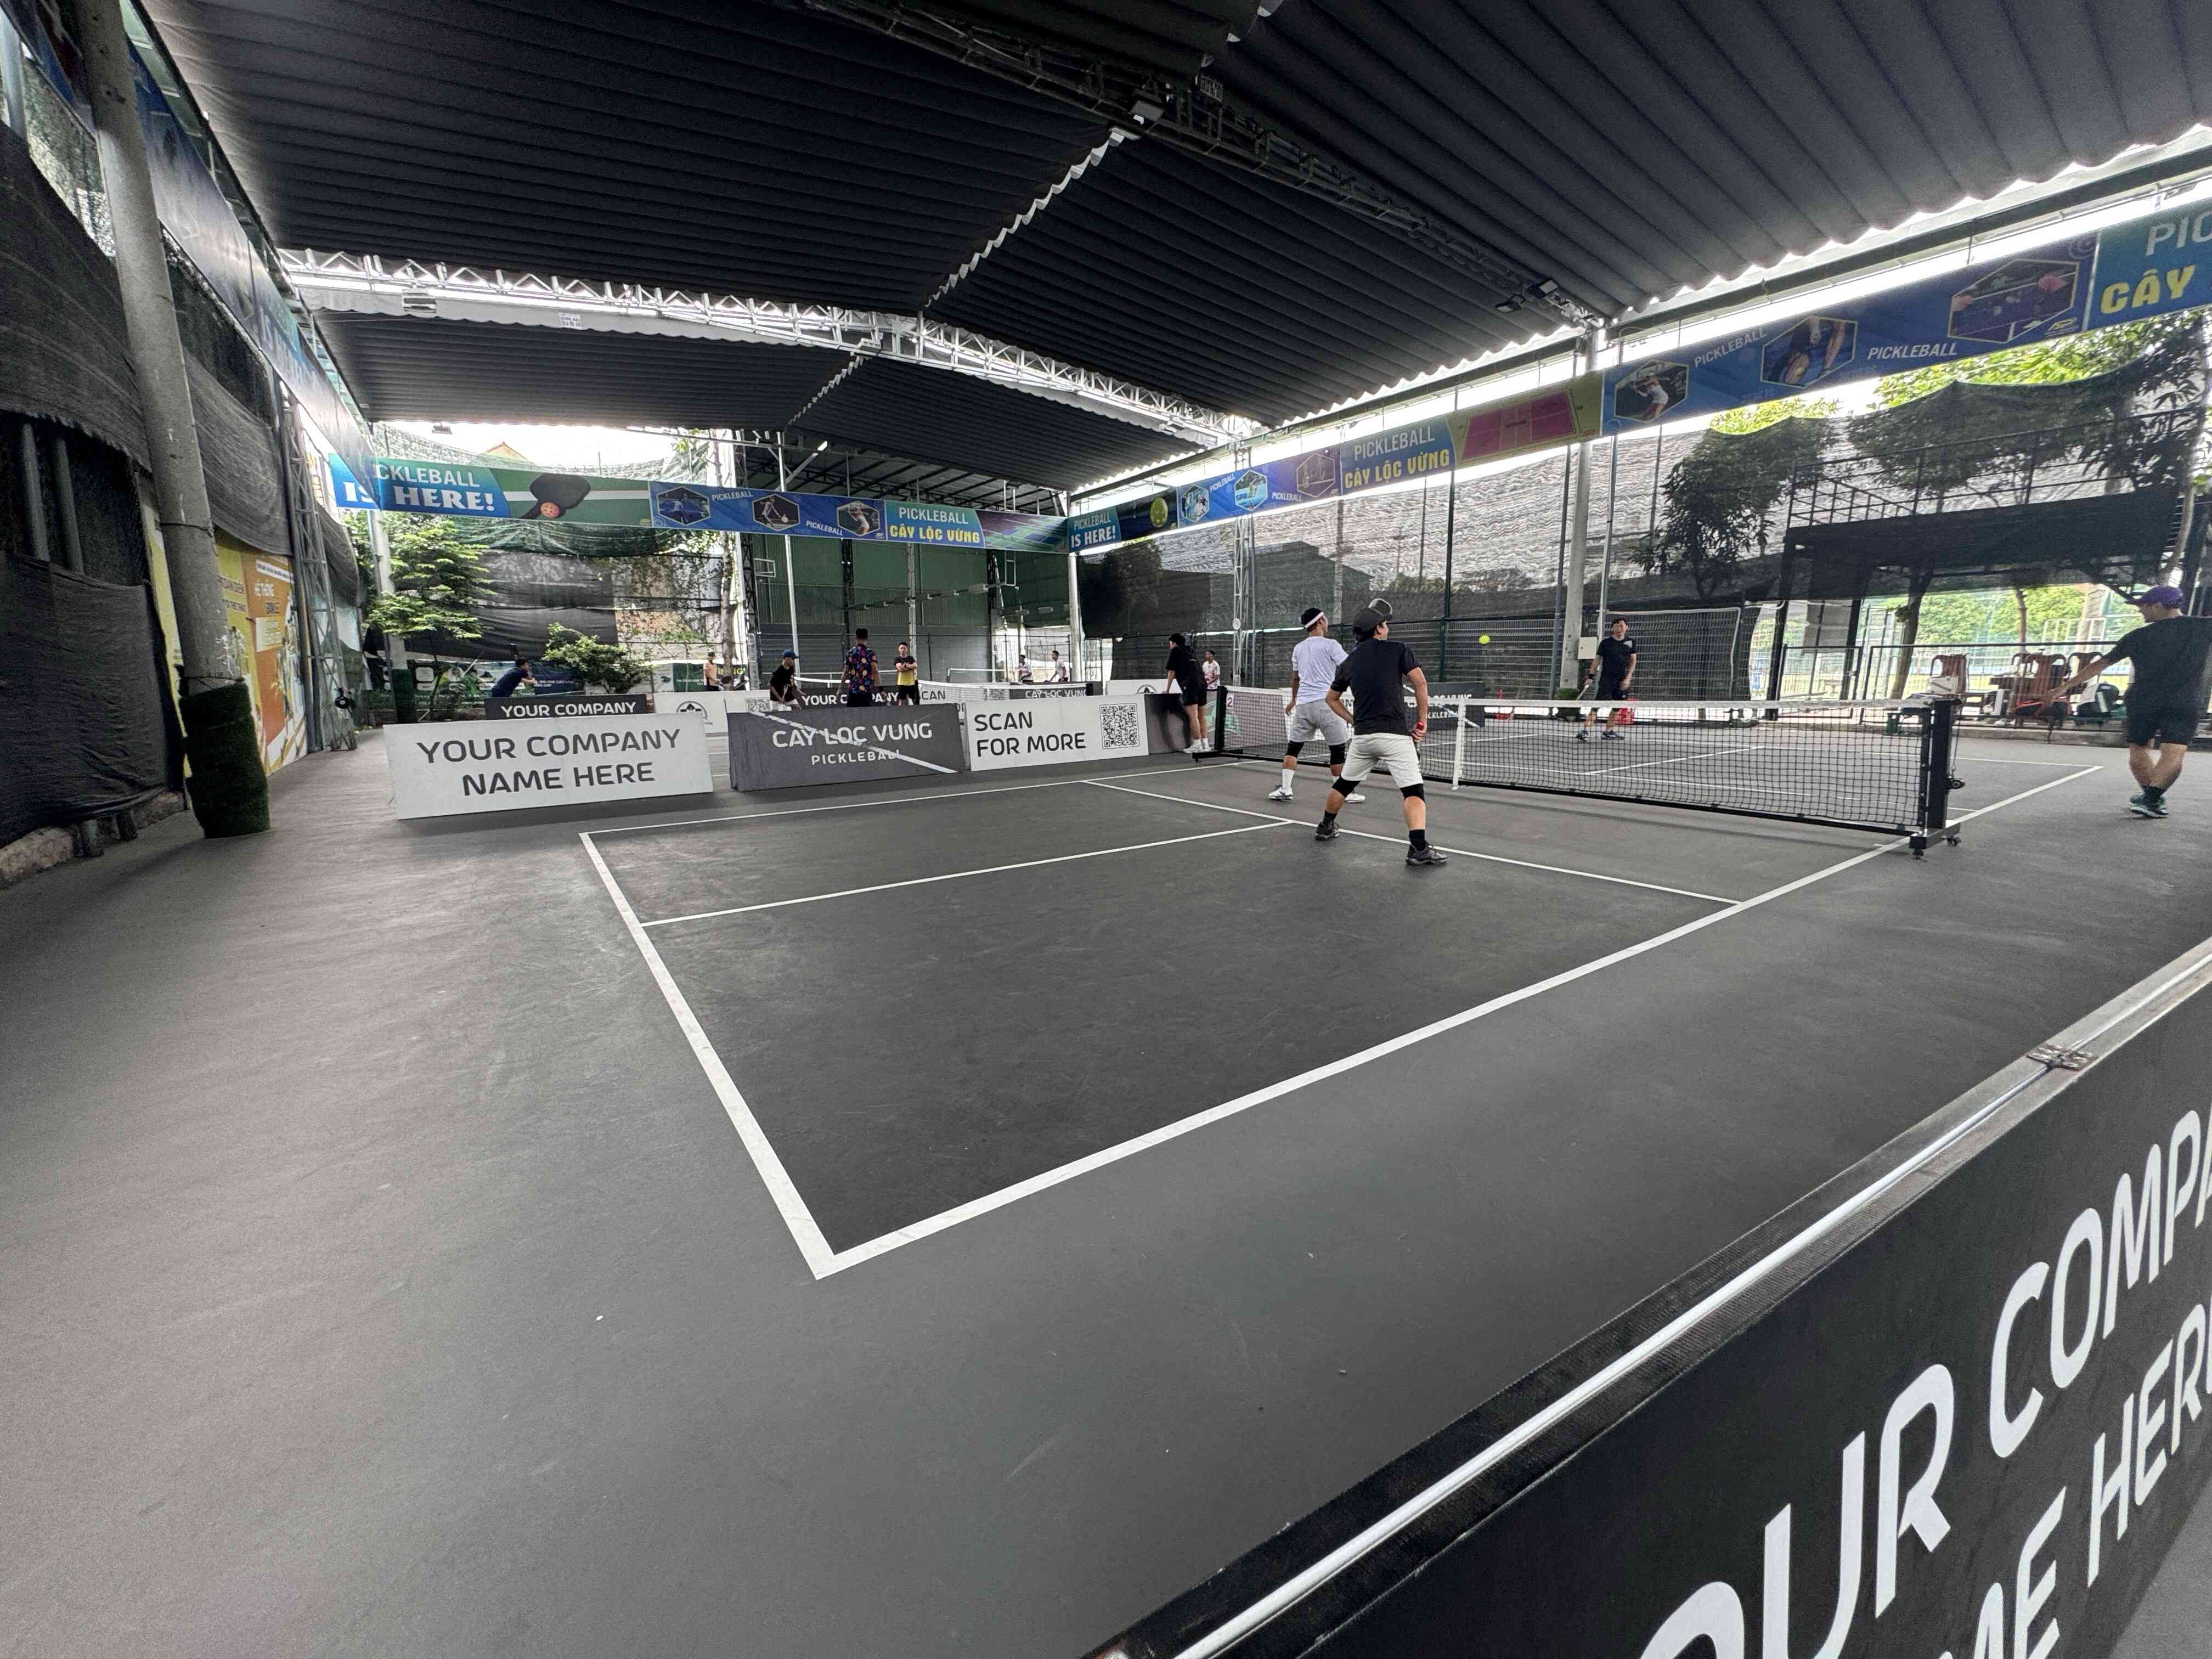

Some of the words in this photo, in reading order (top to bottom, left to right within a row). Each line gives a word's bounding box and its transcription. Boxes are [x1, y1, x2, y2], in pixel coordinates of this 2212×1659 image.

[2100, 265, 2196, 314] CÂY
[1694, 327, 1767, 368] PICKLEBALL
[1867, 342, 1958, 360] PICKLEBALL
[1354, 426, 1436, 461] PICKLEBALL
[376, 464, 480, 488] CKLEBALL
[1345, 466, 1370, 489] CÂY
[1375, 460, 1402, 483] LỘC
[1407, 449, 1450, 475] VỪNG
[1210, 473, 1236, 493] PICKLEBALL
[393, 484, 495, 512] HERE!
[712, 490, 754, 501] PICKLEBALL
[1271, 492, 1303, 502] PICKLEBALL
[898, 507, 969, 525] PICKLEBALL
[1074, 512, 1111, 531] PICKLEBALL
[806, 520, 843, 536] PICKLEBALL
[889, 523, 915, 539] CÂY
[919, 526, 943, 543] LỘC
[946, 528, 980, 544] VỪNG
[1070, 533, 1081, 548] IS
[1084, 525, 1116, 545] HERE!
[802, 694, 837, 706] YOUR
[919, 690, 946, 701] CAN
[1025, 689, 1042, 699] CAY
[500, 703, 550, 718] YOUR
[555, 702, 637, 716] COMPANY
[974, 712, 1033, 731] SCAN
[772, 729, 817, 748] CAY
[824, 726, 867, 745] LOC
[872, 723, 933, 742] VUNG
[977, 737, 1020, 757] FOR
[1028, 732, 1087, 753] MORE
[417, 737, 517, 764] YOUR
[527, 729, 680, 757] COMPANY
[811, 749, 900, 765] PICKLEBALL
[462, 768, 563, 796] NAME
[574, 761, 656, 787] HERE
[2088, 1297, 2212, 1589] HER
